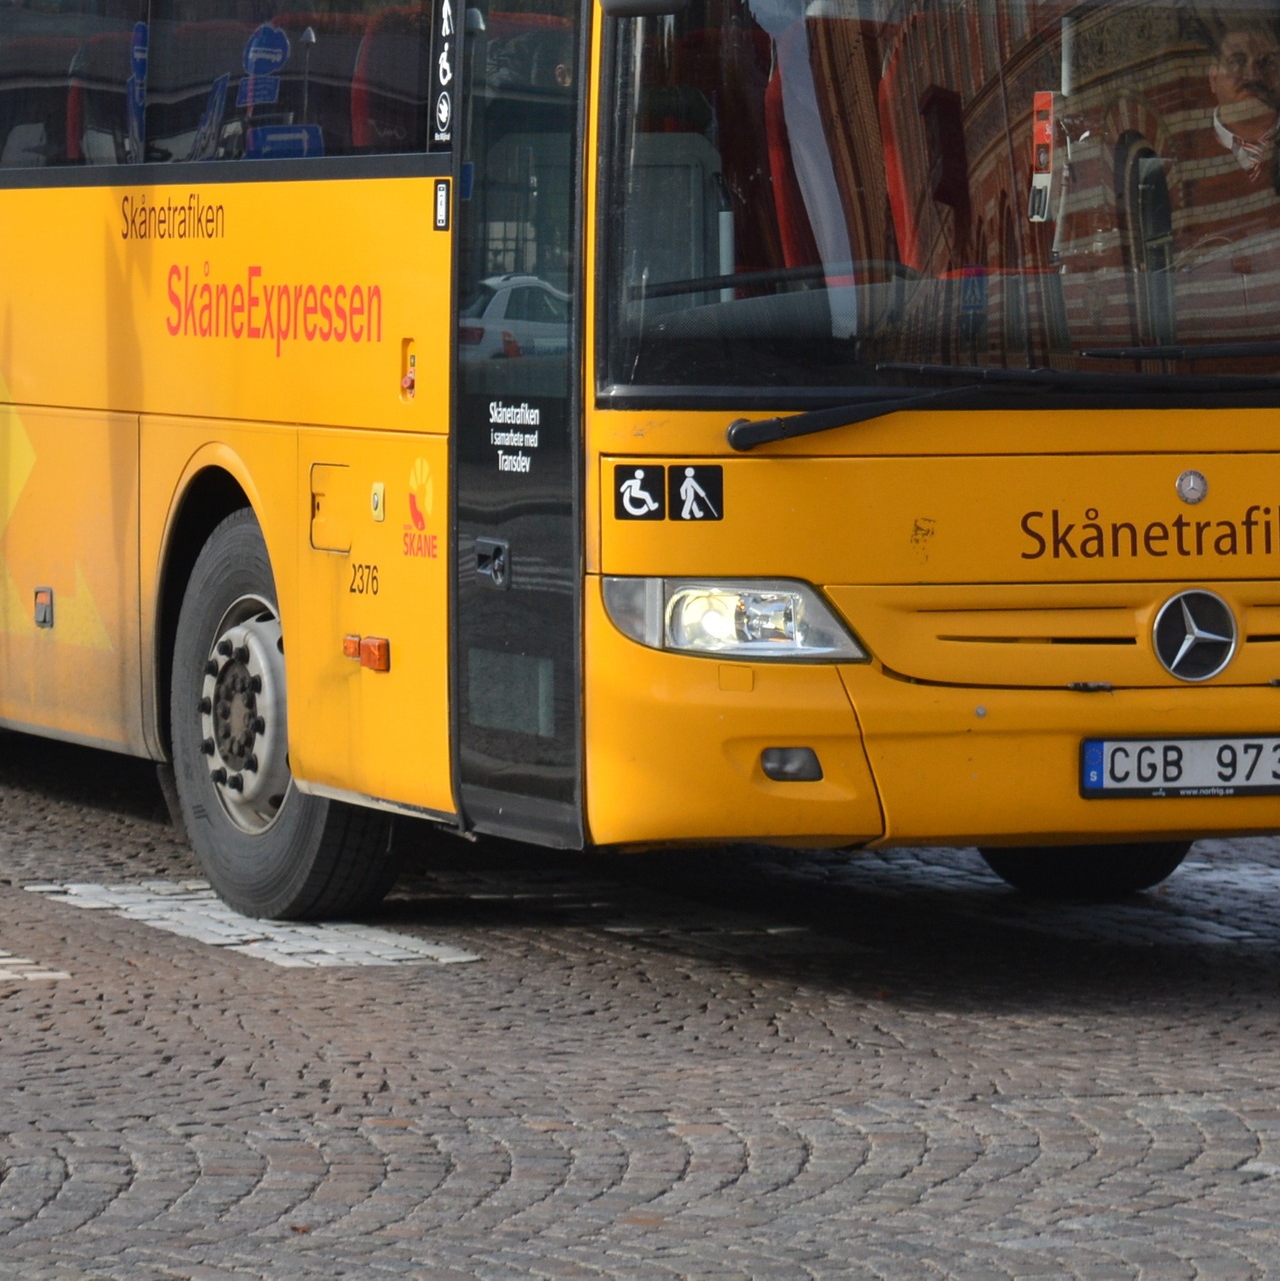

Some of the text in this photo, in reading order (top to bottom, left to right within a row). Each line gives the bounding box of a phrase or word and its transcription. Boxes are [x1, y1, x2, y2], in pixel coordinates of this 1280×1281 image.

[121, 193, 225, 239] Skånetrafiken
[166, 261, 382, 358] SkåneExpressen
[489, 401, 540, 425] Skånetrafiken
[524, 430, 538, 447] med
[497, 450, 531, 473] Transdev
[349, 563, 379, 595] 2376
[1089, 770, 1098, 782] S
[1108, 746, 1184, 784] CGB
